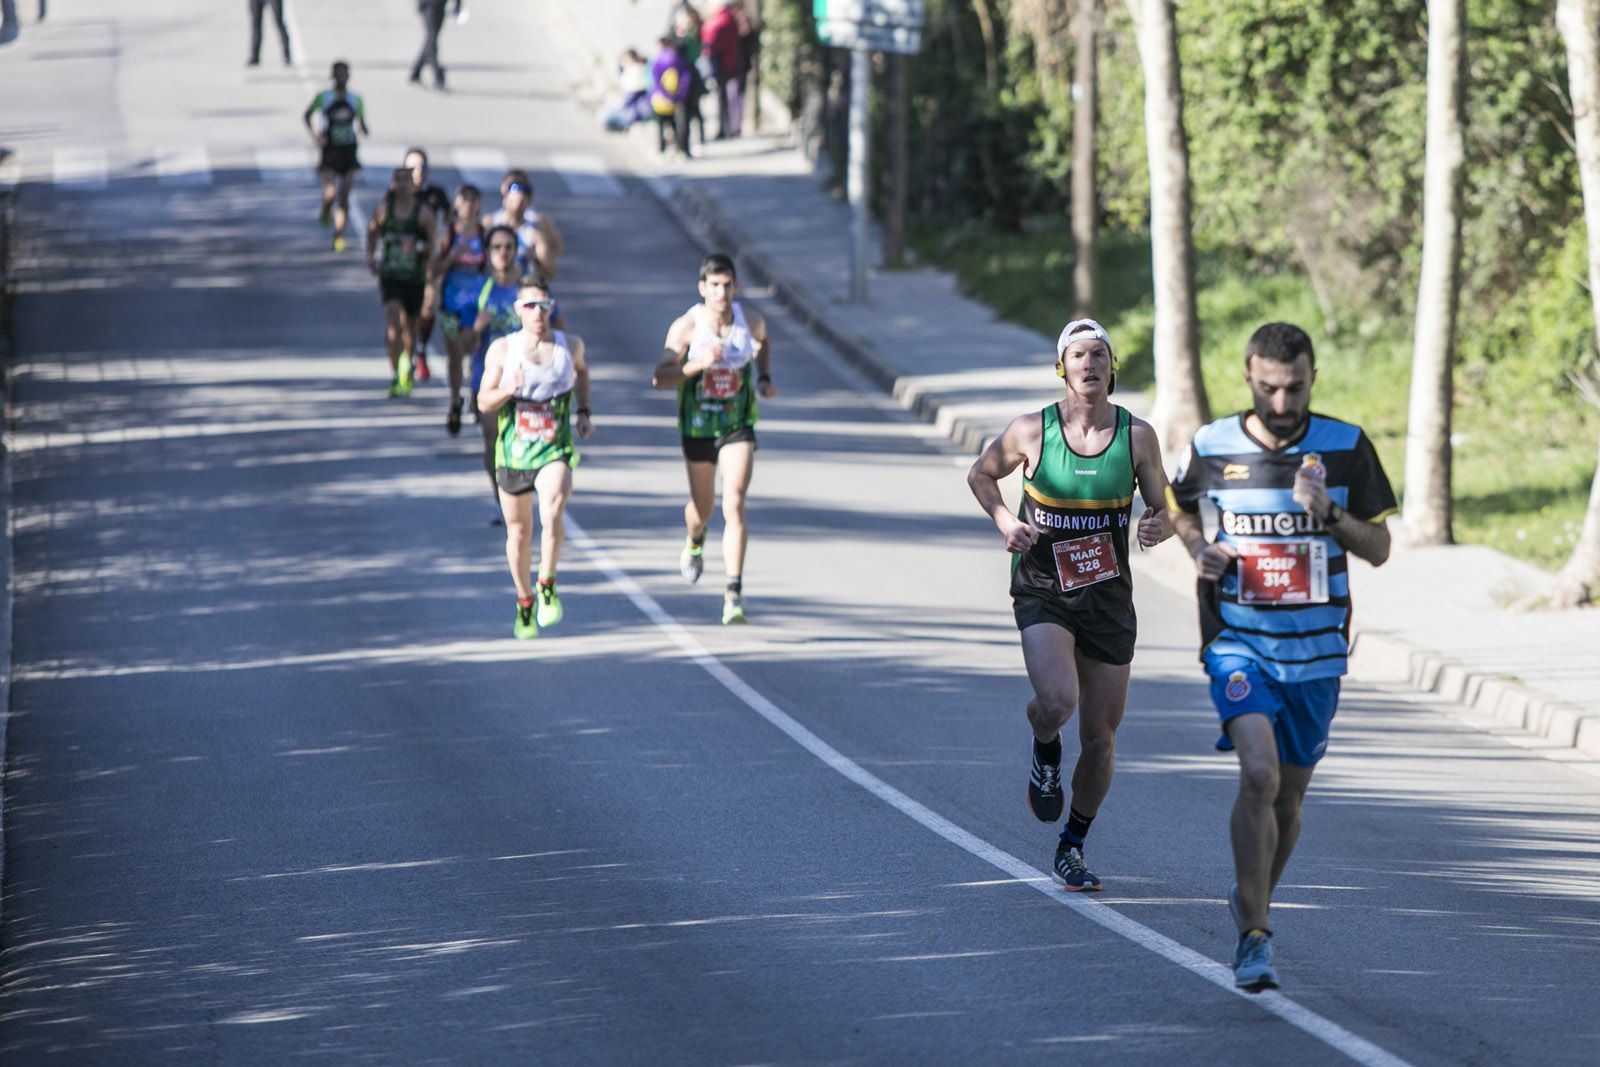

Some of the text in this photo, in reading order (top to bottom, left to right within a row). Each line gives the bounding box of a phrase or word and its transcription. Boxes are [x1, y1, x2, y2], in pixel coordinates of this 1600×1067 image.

[1034, 507, 1110, 530] CERDANYOLA
[1070, 546, 1103, 562] MARC
[1077, 558, 1101, 574] 328
[1256, 557, 1297, 571] JOSEP
[1263, 571, 1291, 587] 314
